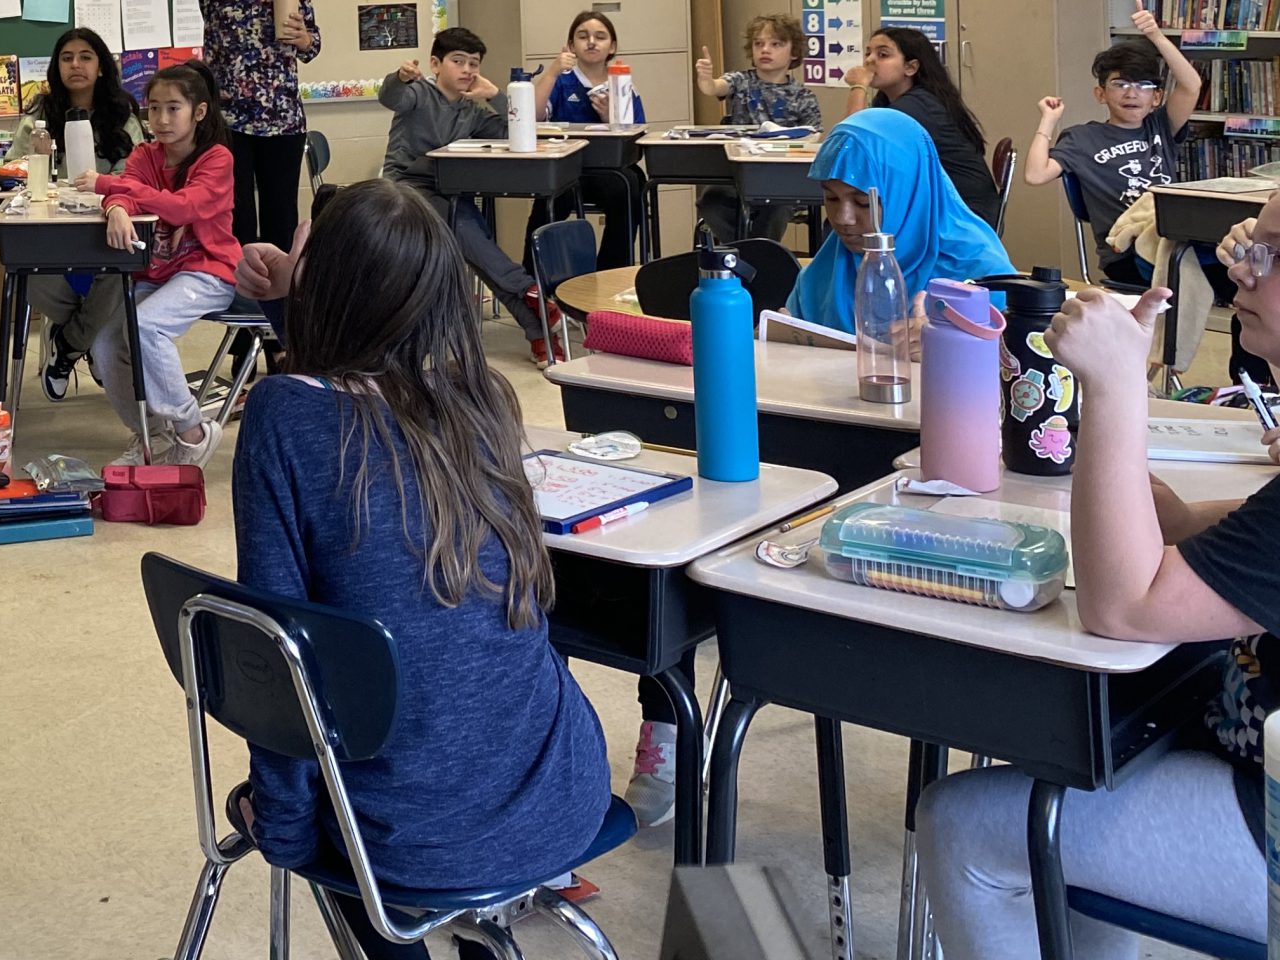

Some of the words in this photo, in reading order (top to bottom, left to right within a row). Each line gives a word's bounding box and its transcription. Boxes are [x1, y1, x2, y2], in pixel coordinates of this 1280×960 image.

[917, 7, 935, 15] three
[807, 13, 819, 32] 8
[808, 37, 820, 56] 9
[806, 64, 823, 80] 10
